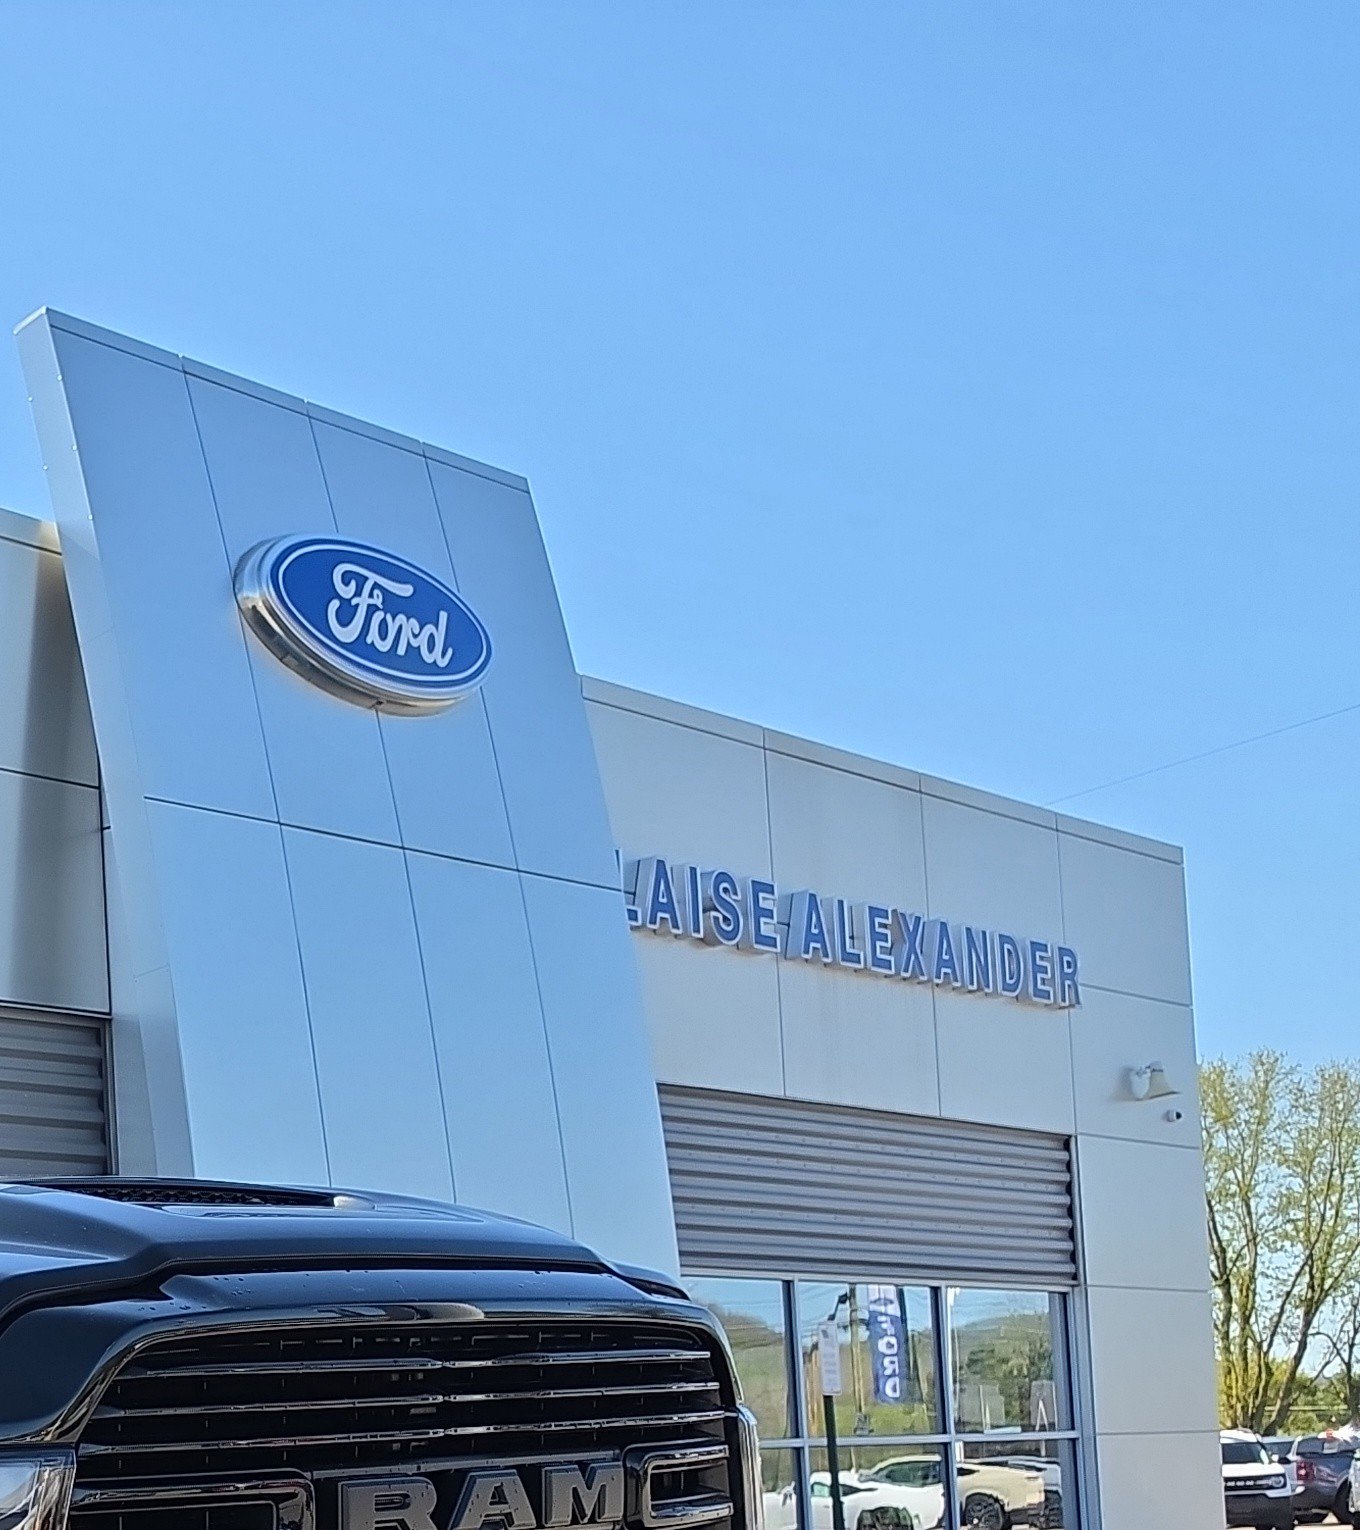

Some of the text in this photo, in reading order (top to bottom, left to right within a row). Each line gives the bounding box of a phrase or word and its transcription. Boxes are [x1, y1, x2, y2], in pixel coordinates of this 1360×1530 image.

[328, 563, 453, 668] Ford
[626, 858, 1082, 1008] AISE ALEXANDER
